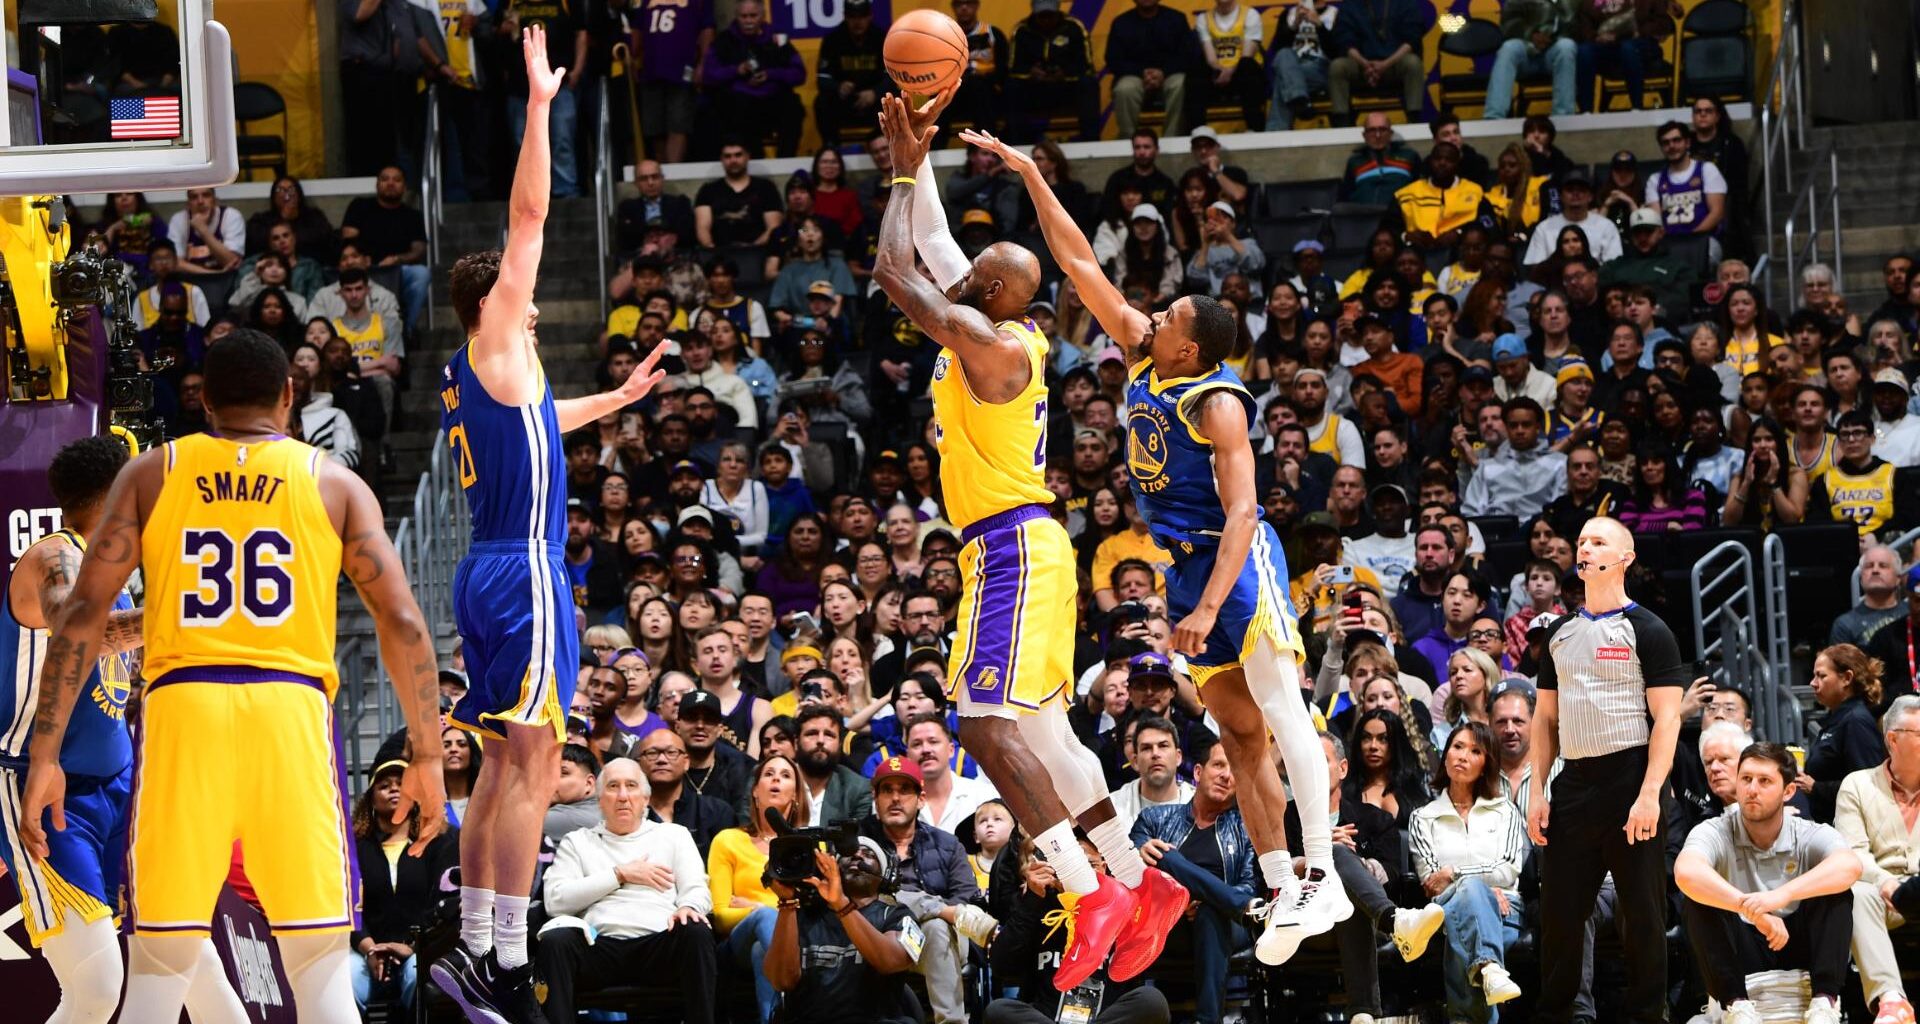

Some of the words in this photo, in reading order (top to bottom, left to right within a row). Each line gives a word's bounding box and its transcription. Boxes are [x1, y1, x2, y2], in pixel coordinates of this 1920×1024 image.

[650, 9, 676, 33] 16
[1148, 432, 1158, 452] 8
[196, 470, 285, 505] SMART
[8, 507, 63, 558] GET
[180, 528, 295, 627] 36
[1597, 650, 1629, 659] Emirates
